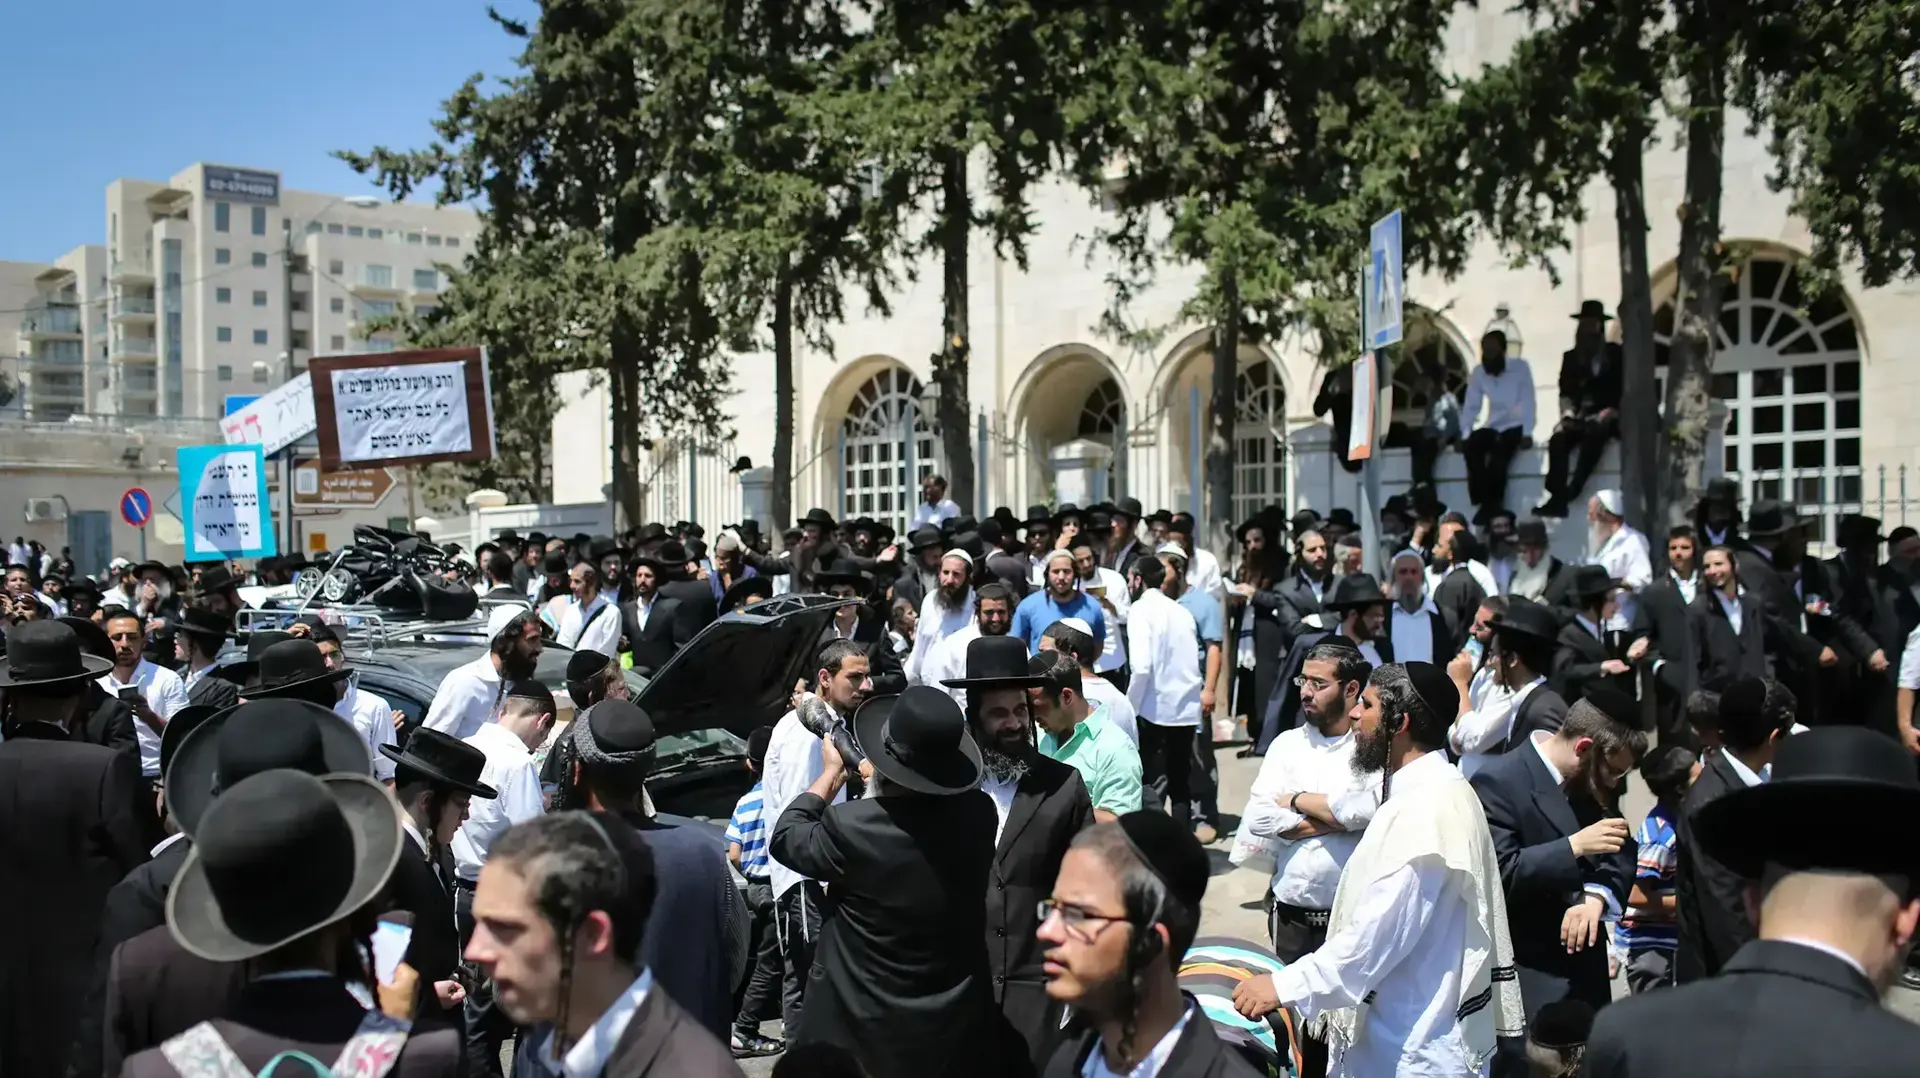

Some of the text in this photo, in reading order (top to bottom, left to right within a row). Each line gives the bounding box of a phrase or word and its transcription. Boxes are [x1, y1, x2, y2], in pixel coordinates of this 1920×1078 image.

[374, 376, 401, 392] ברלנד
[403, 375, 433, 390] אליעזר
[435, 375, 454, 389] הרב
[375, 403, 412, 420] ישראל
[415, 403, 432, 418] עם
[435, 400, 449, 417] כל
[371, 432, 432, 449] באש ובמים
[237, 464, 248, 478] כי
[217, 490, 257, 509] ממשלת
[204, 522, 235, 540] הארץ
